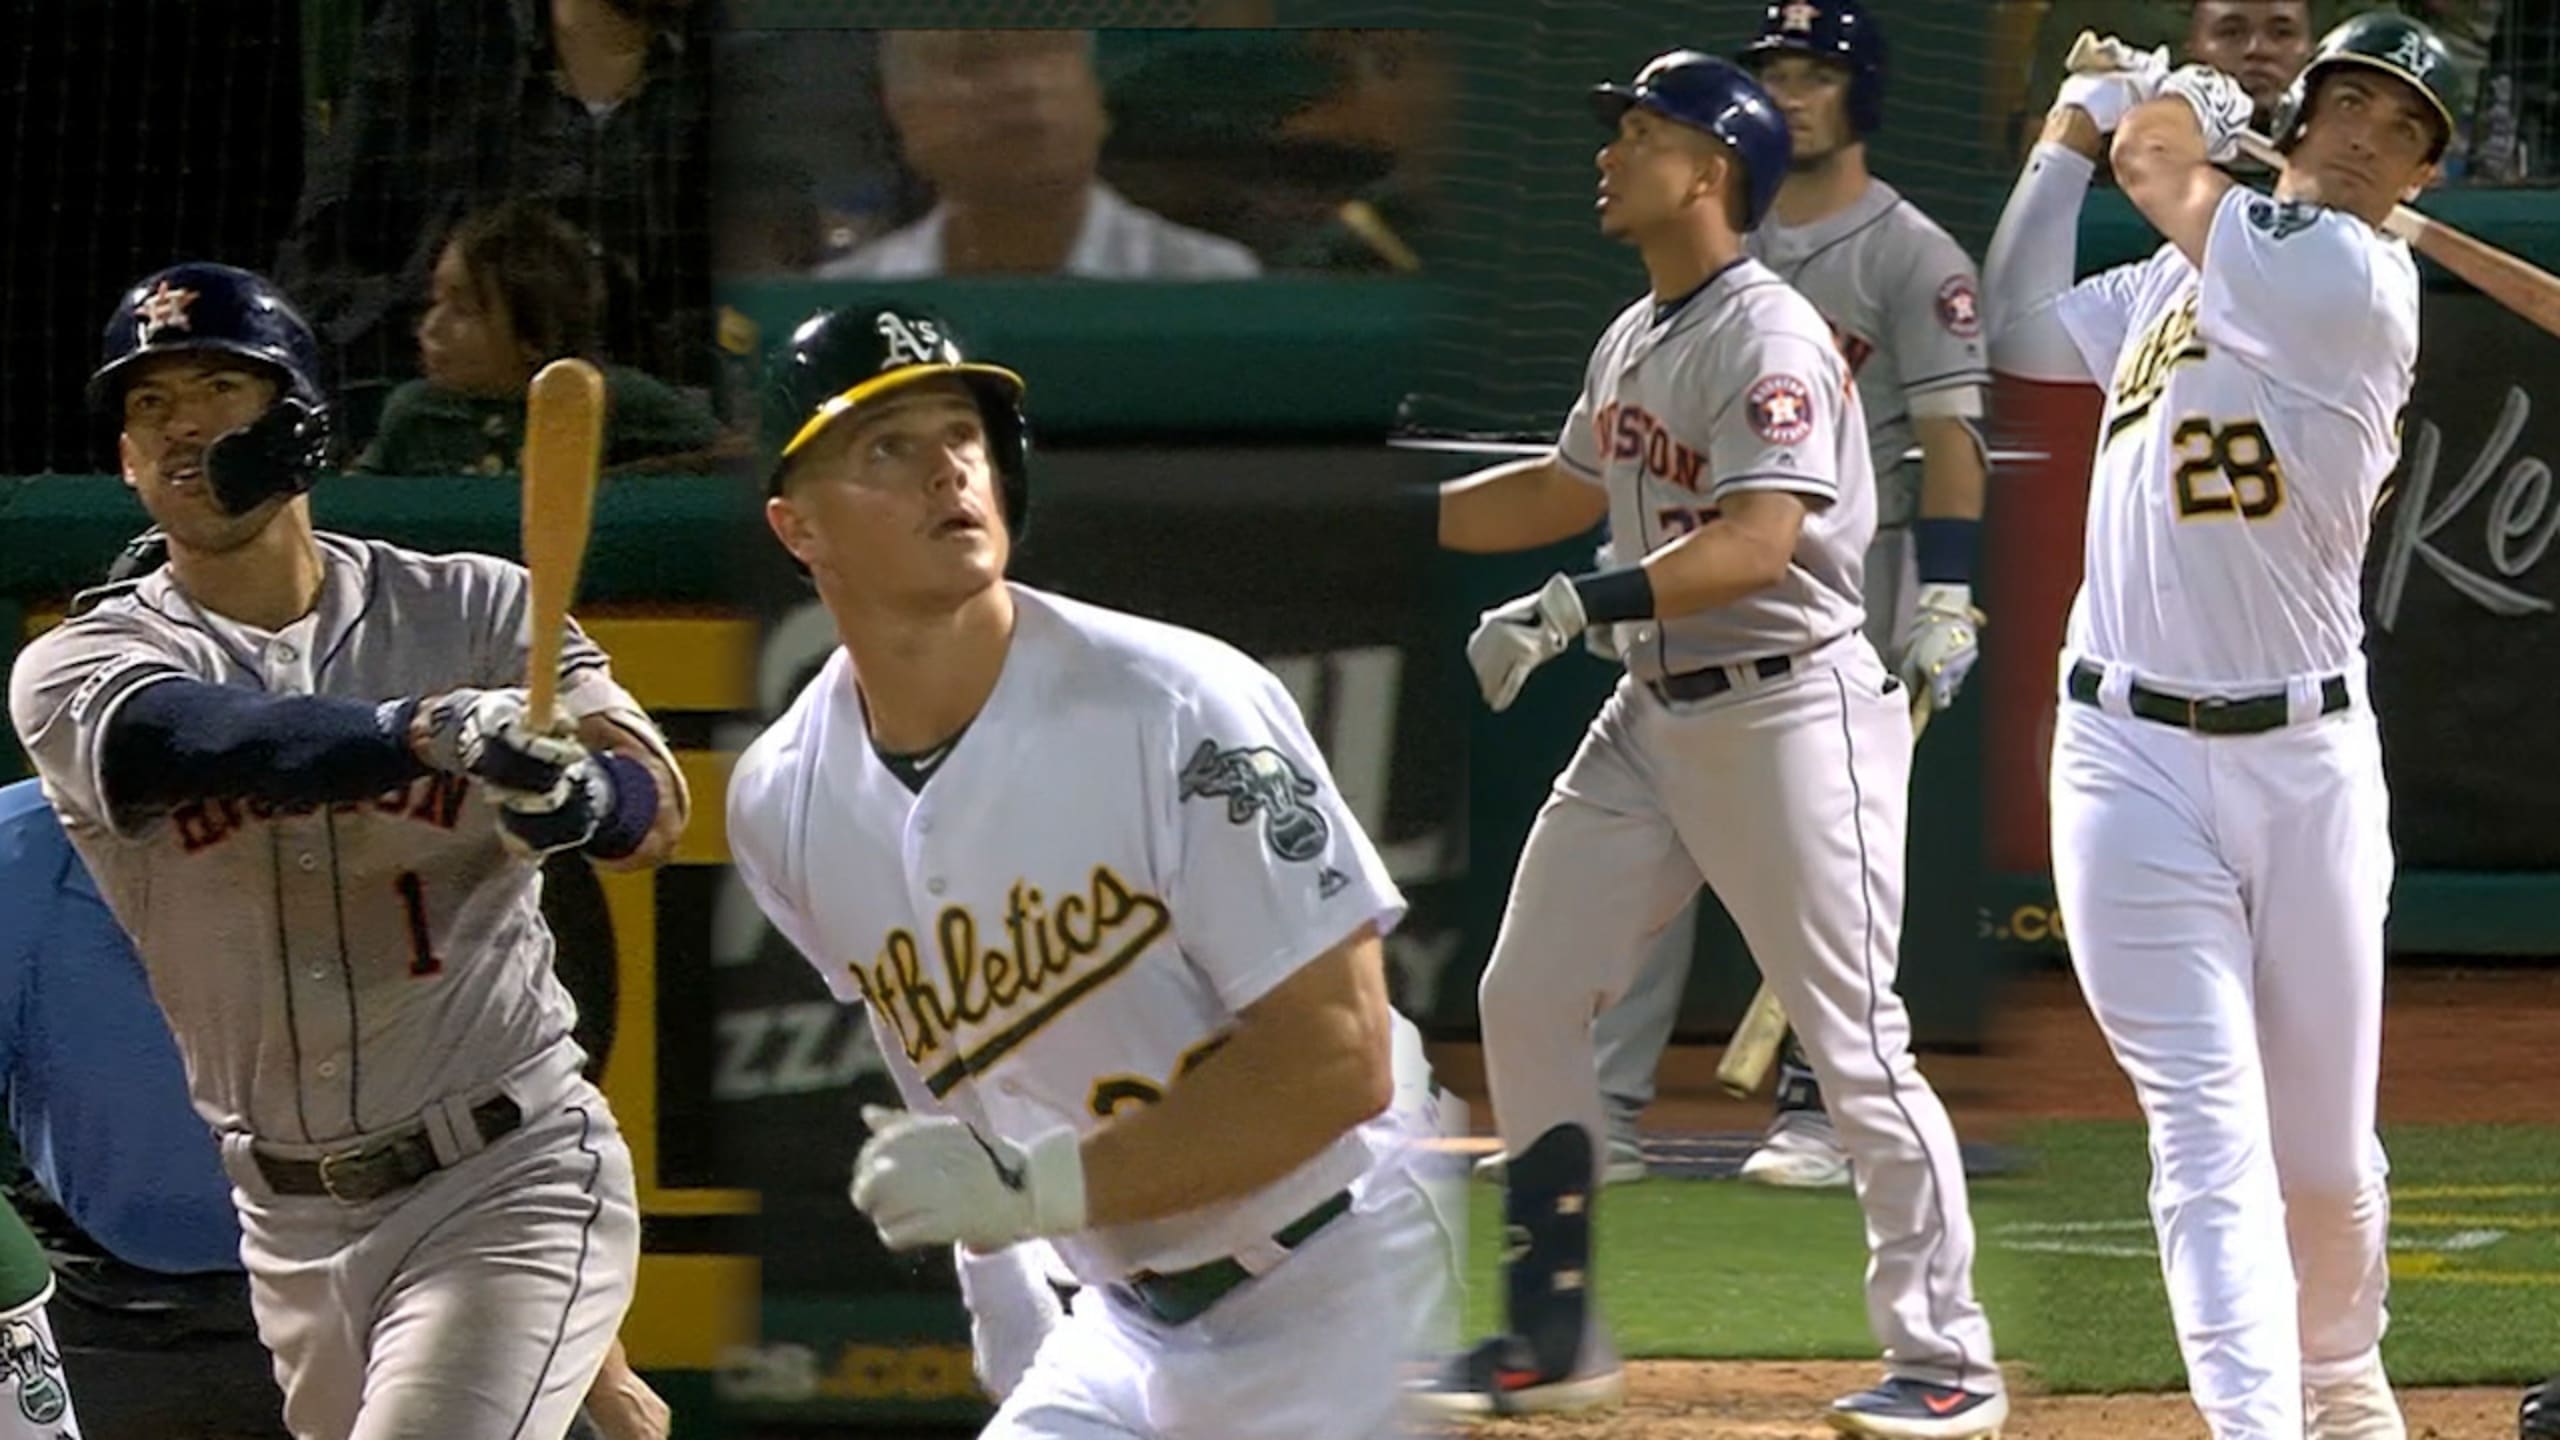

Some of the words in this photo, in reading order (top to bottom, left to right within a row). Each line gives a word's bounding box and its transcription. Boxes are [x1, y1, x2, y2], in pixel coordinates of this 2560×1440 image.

[877, 311, 940, 371] A's
[2172, 416, 2285, 522] 28
[394, 869, 442, 978] 1
